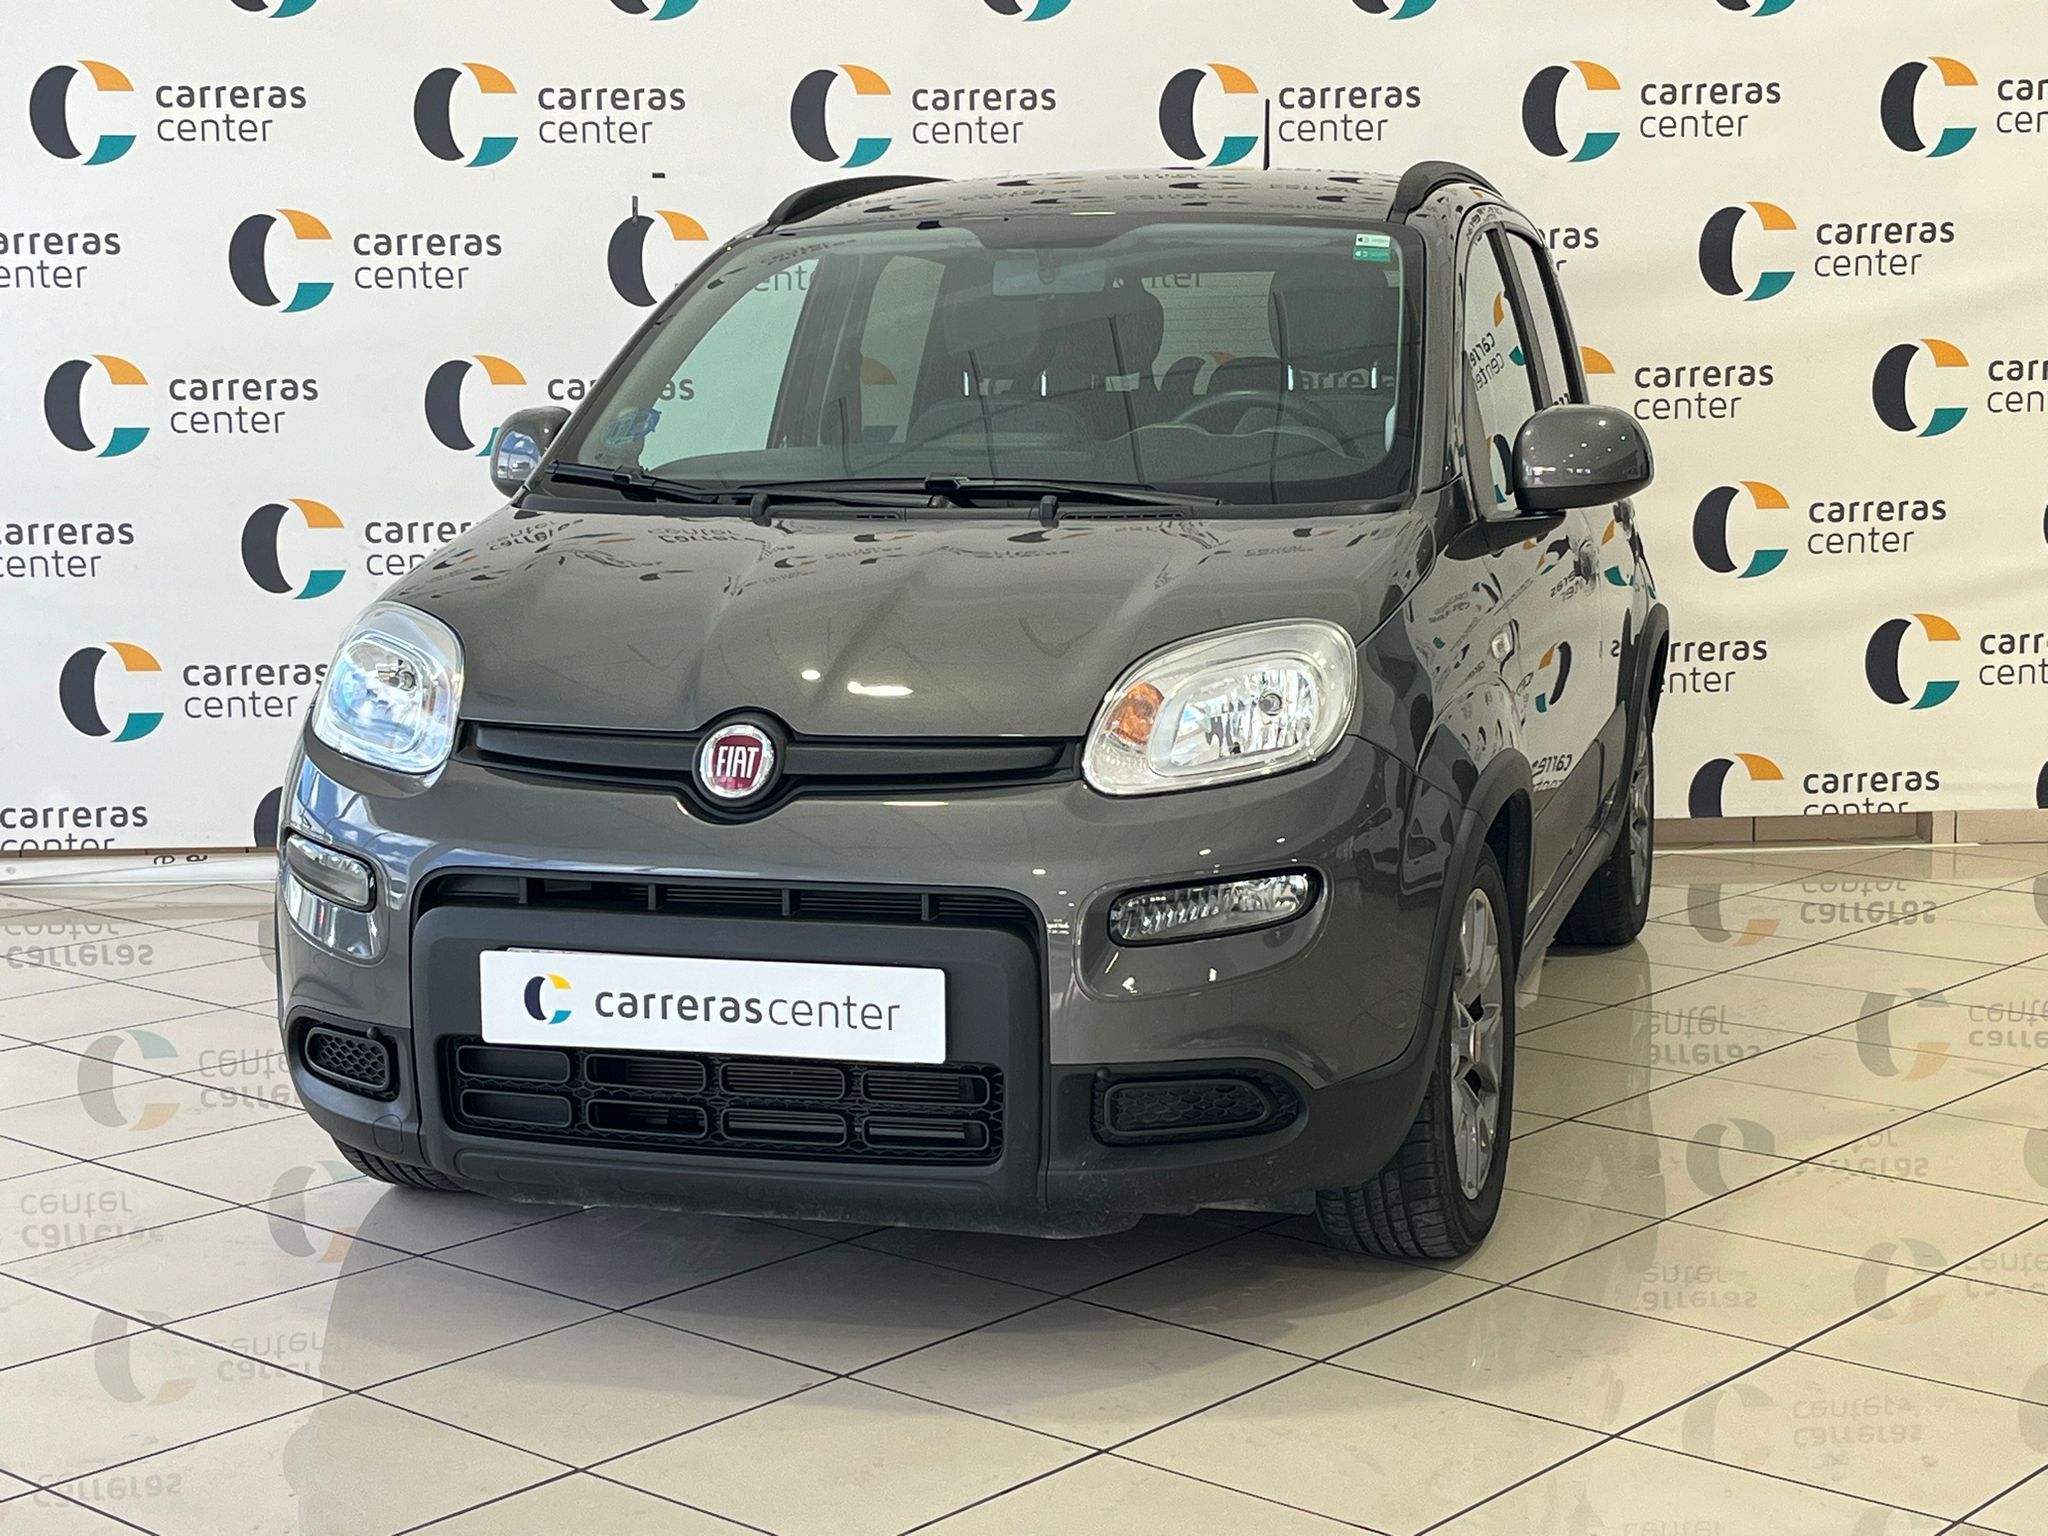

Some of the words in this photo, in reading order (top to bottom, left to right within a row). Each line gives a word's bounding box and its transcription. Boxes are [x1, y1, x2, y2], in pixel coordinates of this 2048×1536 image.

[155, 85, 306, 109] carreras
[538, 87, 685, 111] carreras
[912, 88, 1056, 112] carreras
[1278, 85, 1421, 109] carreras
[1640, 82, 1781, 106] carreras
[157, 114, 273, 142] center
[539, 116, 652, 144] center
[912, 116, 1023, 145] center
[1278, 114, 1388, 142] center
[1639, 110, 1749, 138] center
[1996, 111, 2048, 133] cen
[353, 233, 502, 256] carreras
[1816, 221, 1955, 245] carreras
[0, 259, 88, 288] enter
[1814, 248, 1922, 277] center
[354, 261, 469, 290] center
[1634, 364, 1774, 389] carreras
[169, 378, 318, 401] carreras
[1987, 390, 2048, 413] cen
[1633, 393, 1741, 420] center
[170, 406, 285, 434] center
[1808, 499, 1947, 523] carreras
[0, 522, 134, 545] arreras
[1807, 527, 1914, 555] center
[1669, 640, 1768, 662] rreras
[1980, 633, 2048, 655] carr
[1669, 667, 1736, 693] nter
[1979, 658, 2048, 685] cent
[184, 690, 298, 718] center
[716, 745, 760, 779] FIAT
[1803, 770, 1940, 794] carreras
[0, 805, 148, 829] carreras
